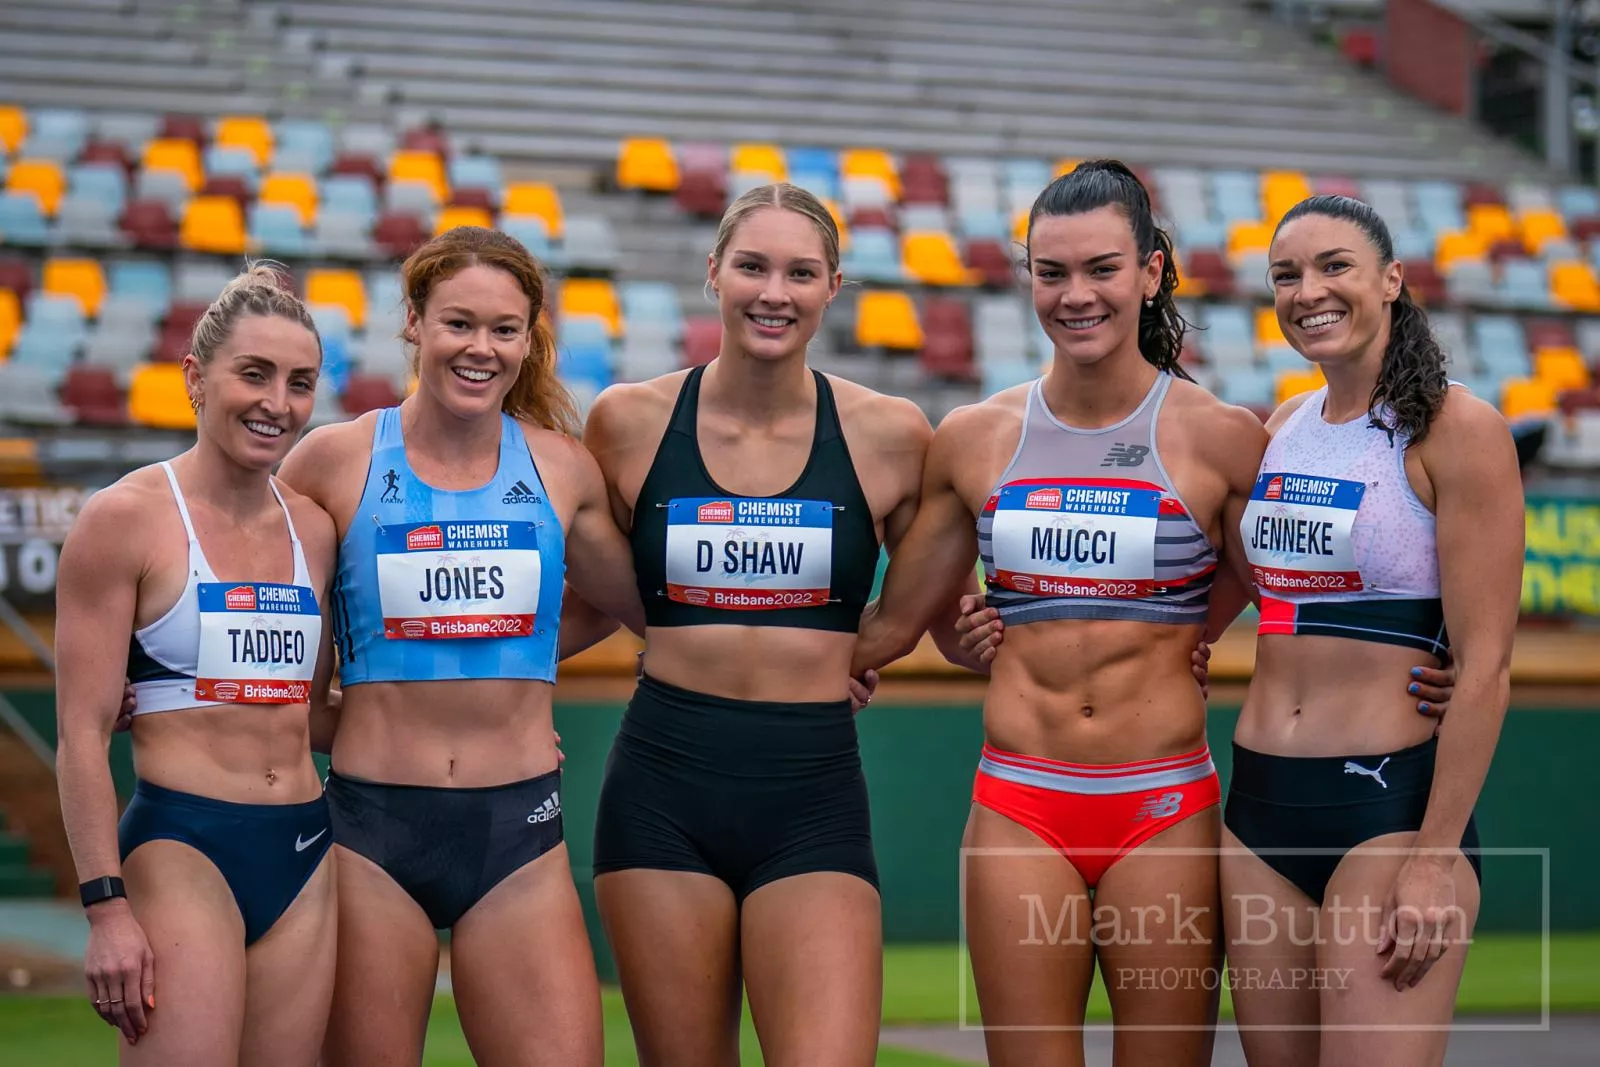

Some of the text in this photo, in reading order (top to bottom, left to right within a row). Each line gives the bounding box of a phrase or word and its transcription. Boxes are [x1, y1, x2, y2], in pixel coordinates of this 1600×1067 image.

[1284, 477, 1339, 496] CHEMIST
[502, 494, 542, 504] adidas
[1066, 489, 1130, 505] CHEMIST
[1283, 494, 1333, 504] WAREHOUSE
[738, 502, 802, 516] CHEMIST
[1065, 504, 1126, 514] WAREHOUSE
[738, 517, 800, 525] WAREHOUSE
[409, 534, 441, 542] CHEMIST
[447, 524, 509, 539] CHEMIST
[1251, 516, 1334, 556] JENNEKE
[448, 540, 509, 548] WAREHOUSE
[1031, 526, 1116, 565] MUCCI
[696, 540, 804, 575] D SHAW
[419, 566, 504, 602] JONES
[1265, 572, 1346, 588] Brisbane2022
[259, 586, 300, 603] CHEMIST
[1039, 580, 1137, 596] Brisbane2022
[227, 594, 254, 602] CHEMIST
[714, 592, 812, 606] Brisbane2022
[260, 603, 301, 612] WAREHOUSE
[431, 619, 522, 635] Brisbane2022
[228, 629, 305, 665] TADDEO
[244, 684, 304, 699] Brisbane2022
